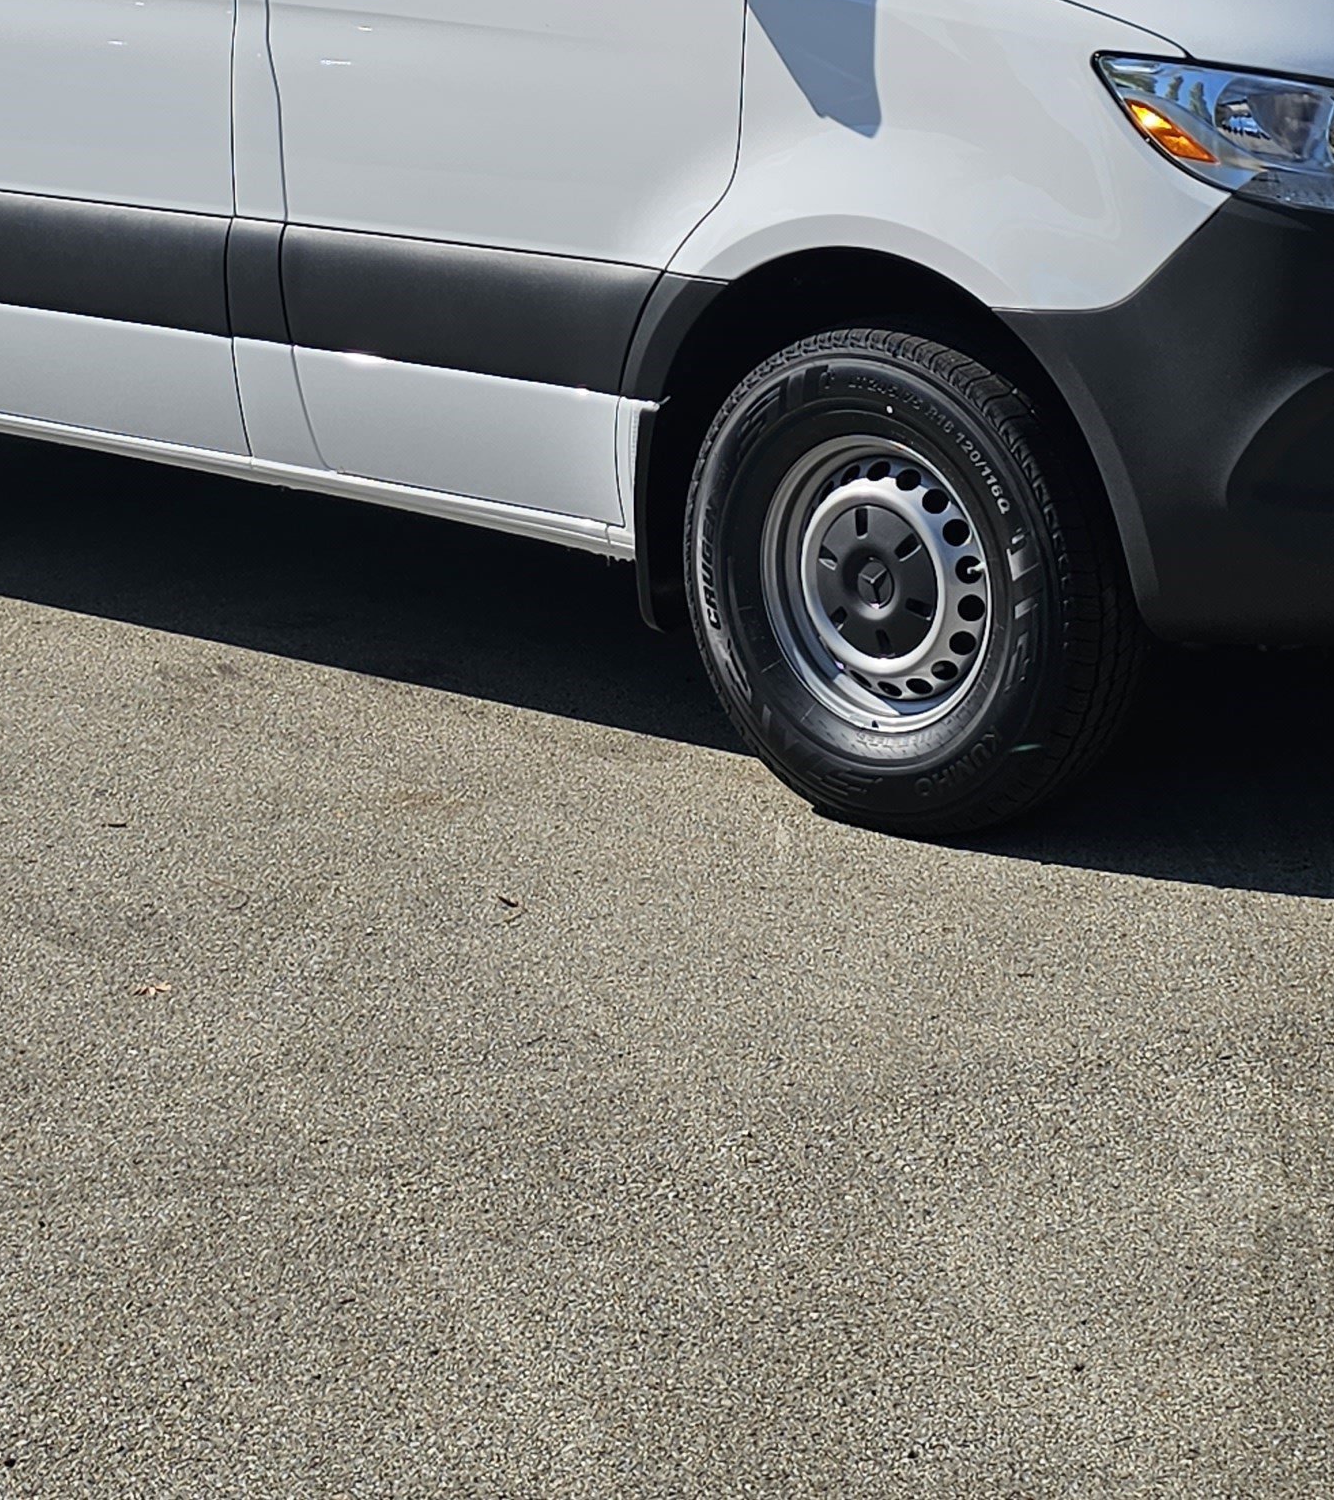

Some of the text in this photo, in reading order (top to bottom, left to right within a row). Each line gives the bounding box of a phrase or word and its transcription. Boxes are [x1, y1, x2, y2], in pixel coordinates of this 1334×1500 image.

[956, 431, 1012, 516] 120/116Q
[701, 501, 723, 631] CRUGEN
[914, 725, 1003, 798] KUMHO
